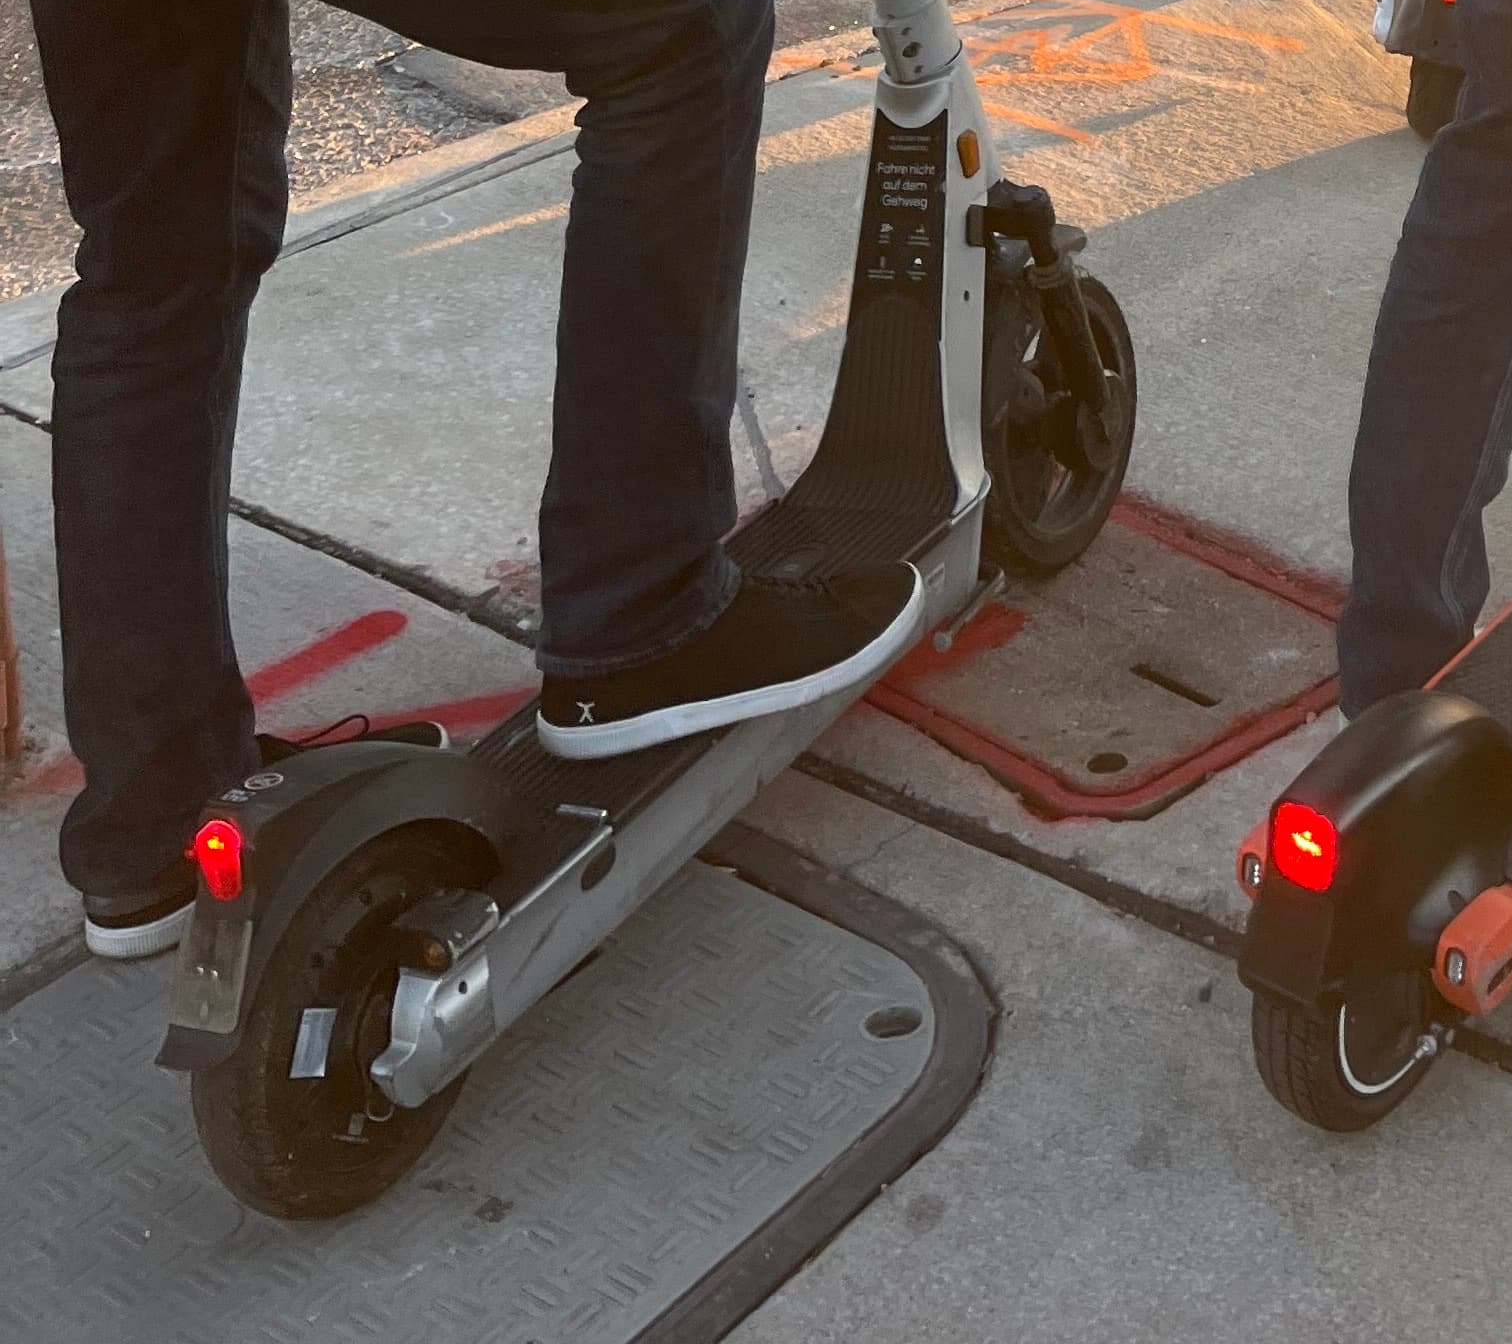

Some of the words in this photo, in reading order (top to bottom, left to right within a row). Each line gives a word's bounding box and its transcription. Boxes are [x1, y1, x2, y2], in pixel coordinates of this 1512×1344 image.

[909, 164, 936, 175] nicht
[881, 179, 901, 190] auf
[902, 180, 928, 191] dem
